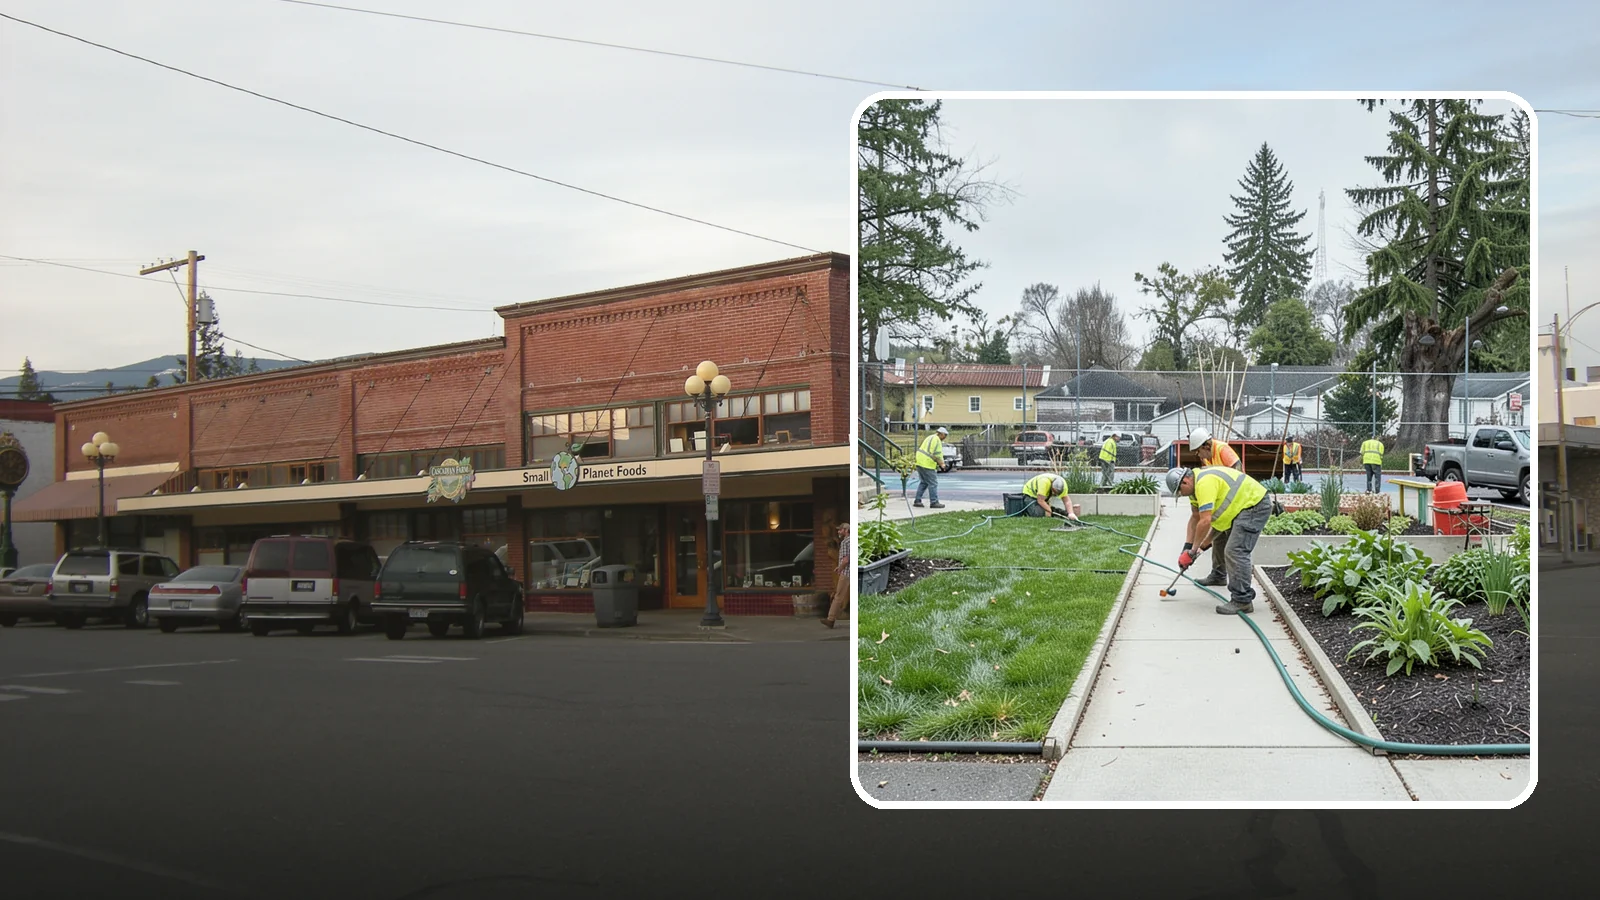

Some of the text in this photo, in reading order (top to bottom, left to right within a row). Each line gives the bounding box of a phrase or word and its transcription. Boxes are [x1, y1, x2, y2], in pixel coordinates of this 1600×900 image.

[523, 464, 647, 483] Small Planet Foods
